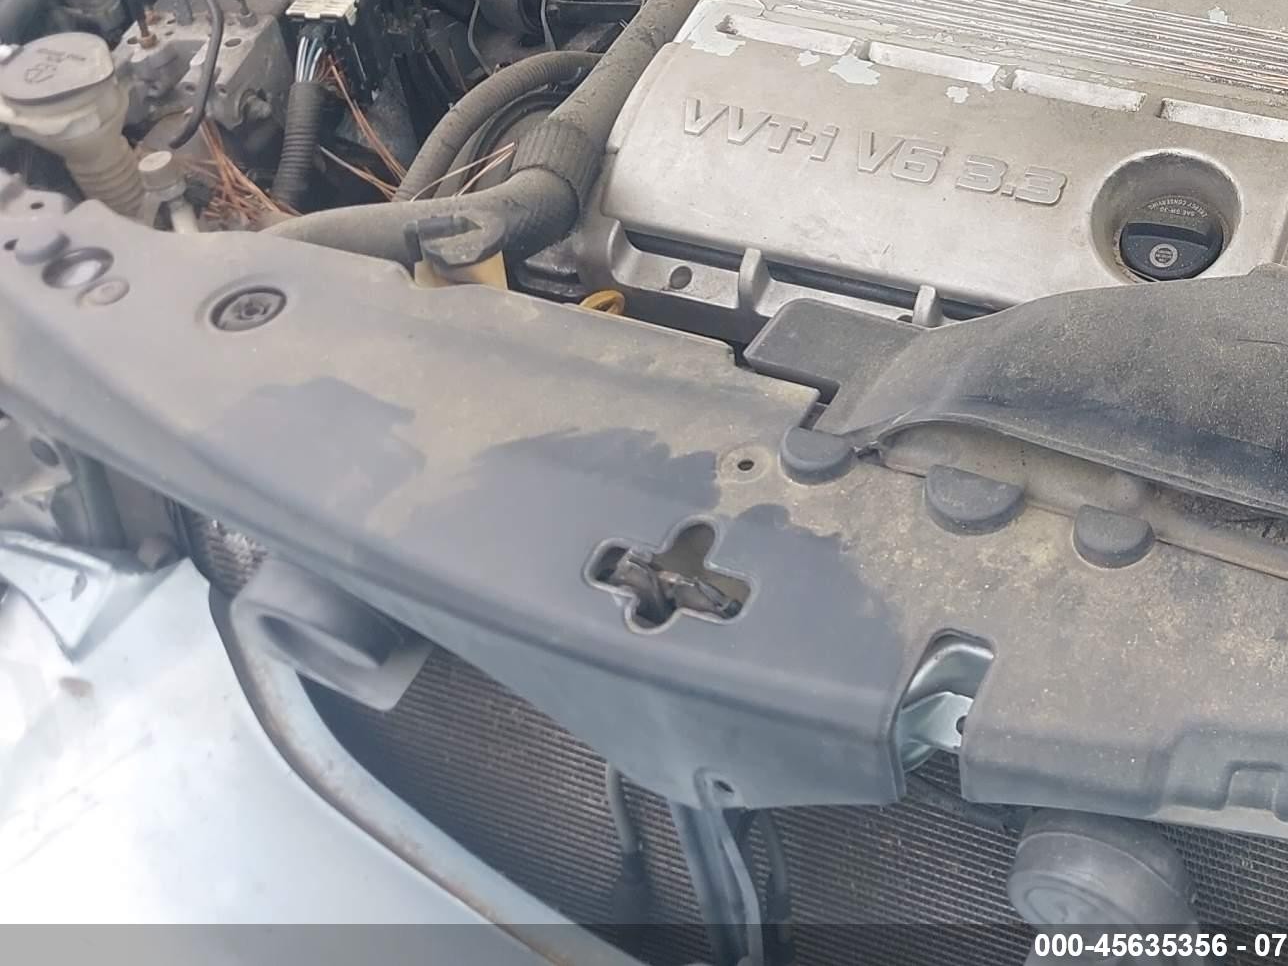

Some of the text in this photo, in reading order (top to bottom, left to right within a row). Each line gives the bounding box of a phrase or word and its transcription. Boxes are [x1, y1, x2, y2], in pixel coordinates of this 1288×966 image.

[681, 97, 1070, 206] VVT-i V6 3.3
